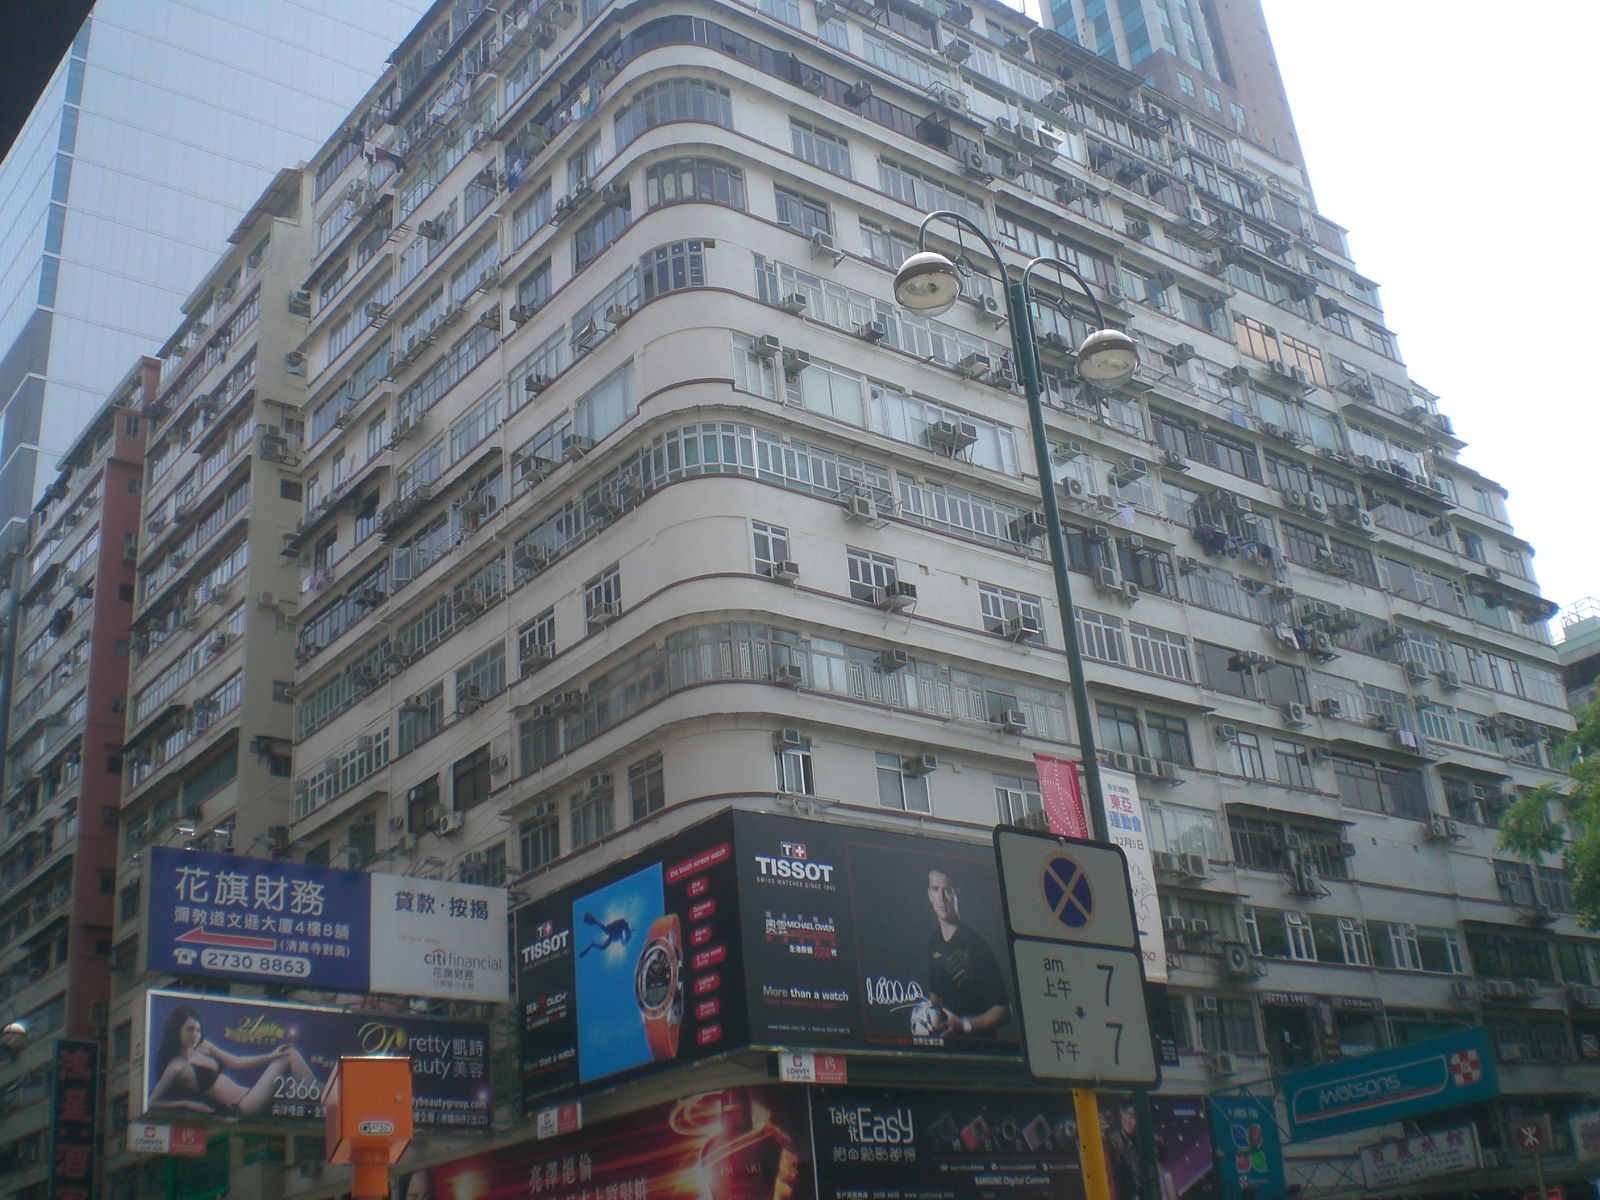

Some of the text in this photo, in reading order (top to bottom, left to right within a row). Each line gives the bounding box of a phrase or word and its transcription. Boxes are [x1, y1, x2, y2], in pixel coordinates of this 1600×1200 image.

[1109, 795, 1133, 813] 東亞
[1109, 811, 1142, 832] 運動會
[1116, 837, 1144, 850] 12月5日
[755, 856, 833, 882] TISSOT
[175, 866, 325, 916] 花旗財務
[521, 930, 570, 964] TISSOT
[207, 952, 305, 975] 2730 8863
[424, 949, 502, 974] citifinancial
[763, 984, 848, 1002] More than a watch
[1043, 977, 1072, 1000] 上午
[1044, 957, 1114, 1007] am 7
[452, 1038, 484, 1057] 凱詩
[1050, 1040, 1080, 1063] 下午
[1052, 1020, 1123, 1066] pm 7
[412, 1058, 484, 1080] auty 美容
[273, 1076, 320, 1101] 2366
[828, 1106, 914, 1144] Take it Easy
[1003, 1177, 1025, 1187] Digital
